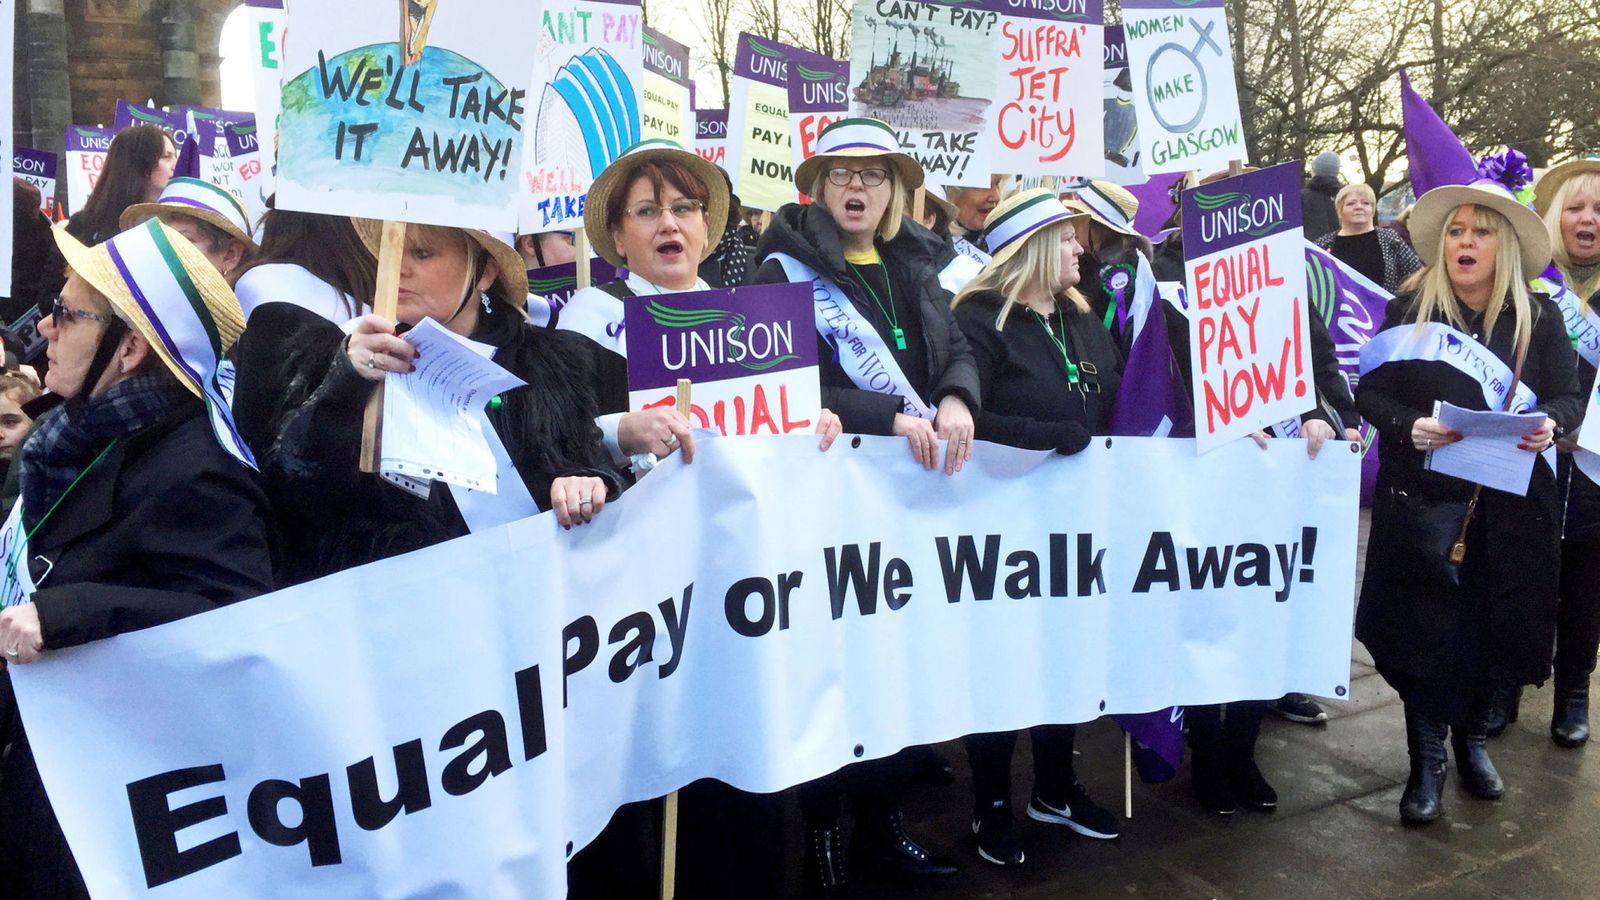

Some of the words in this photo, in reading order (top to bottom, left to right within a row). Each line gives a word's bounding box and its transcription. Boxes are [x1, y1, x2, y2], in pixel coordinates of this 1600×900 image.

[543, 6, 592, 44] AN'T
[602, 12, 639, 48] PAY
[876, 0, 940, 21] CAN'T
[950, 8, 998, 36] PAY?
[1126, 15, 1184, 40] WOMEN
[1002, 21, 1086, 62] SUFFRA'
[750, 54, 788, 81] UNIS
[318, 49, 425, 113] WE'LL
[442, 72, 526, 131] TAKE
[803, 82, 849, 104] UNIS
[1009, 66, 1069, 102] JET
[1153, 74, 1194, 103] MAKE
[644, 89, 665, 106] EQUAL
[667, 98, 679, 111] PAY
[755, 103, 788, 118] EQUAL
[643, 114, 664, 132] PAY
[666, 122, 679, 137] UP
[696, 120, 728, 135] ISON
[752, 127, 783, 145] PAY
[80, 135, 115, 150] UNIS
[335, 121, 379, 161] IT
[400, 127, 512, 183] AWAY!
[922, 132, 978, 153] TAKE
[1152, 120, 1238, 167] GLASGOW
[13, 157, 45, 173] SON
[527, 165, 583, 194] WE'LL
[909, 152, 970, 180] WAY!
[538, 193, 587, 228] TAKE
[1201, 193, 1284, 243] UNISON
[1194, 244, 1285, 310] EQUAL
[662, 320, 793, 370] UNISON
[848, 333, 868, 358] FOR
[1199, 297, 1260, 374] PAY
[1203, 297, 1306, 433] NOW!
[1489, 377, 1506, 397] FOR
[642, 384, 811, 436] UAL
[126, 663, 547, 889] Equal
[563, 582, 694, 709] Pay
[725, 570, 804, 638] or
[823, 541, 914, 620] We
[935, 533, 1107, 604] Walk
[1132, 526, 1318, 603] Away!
